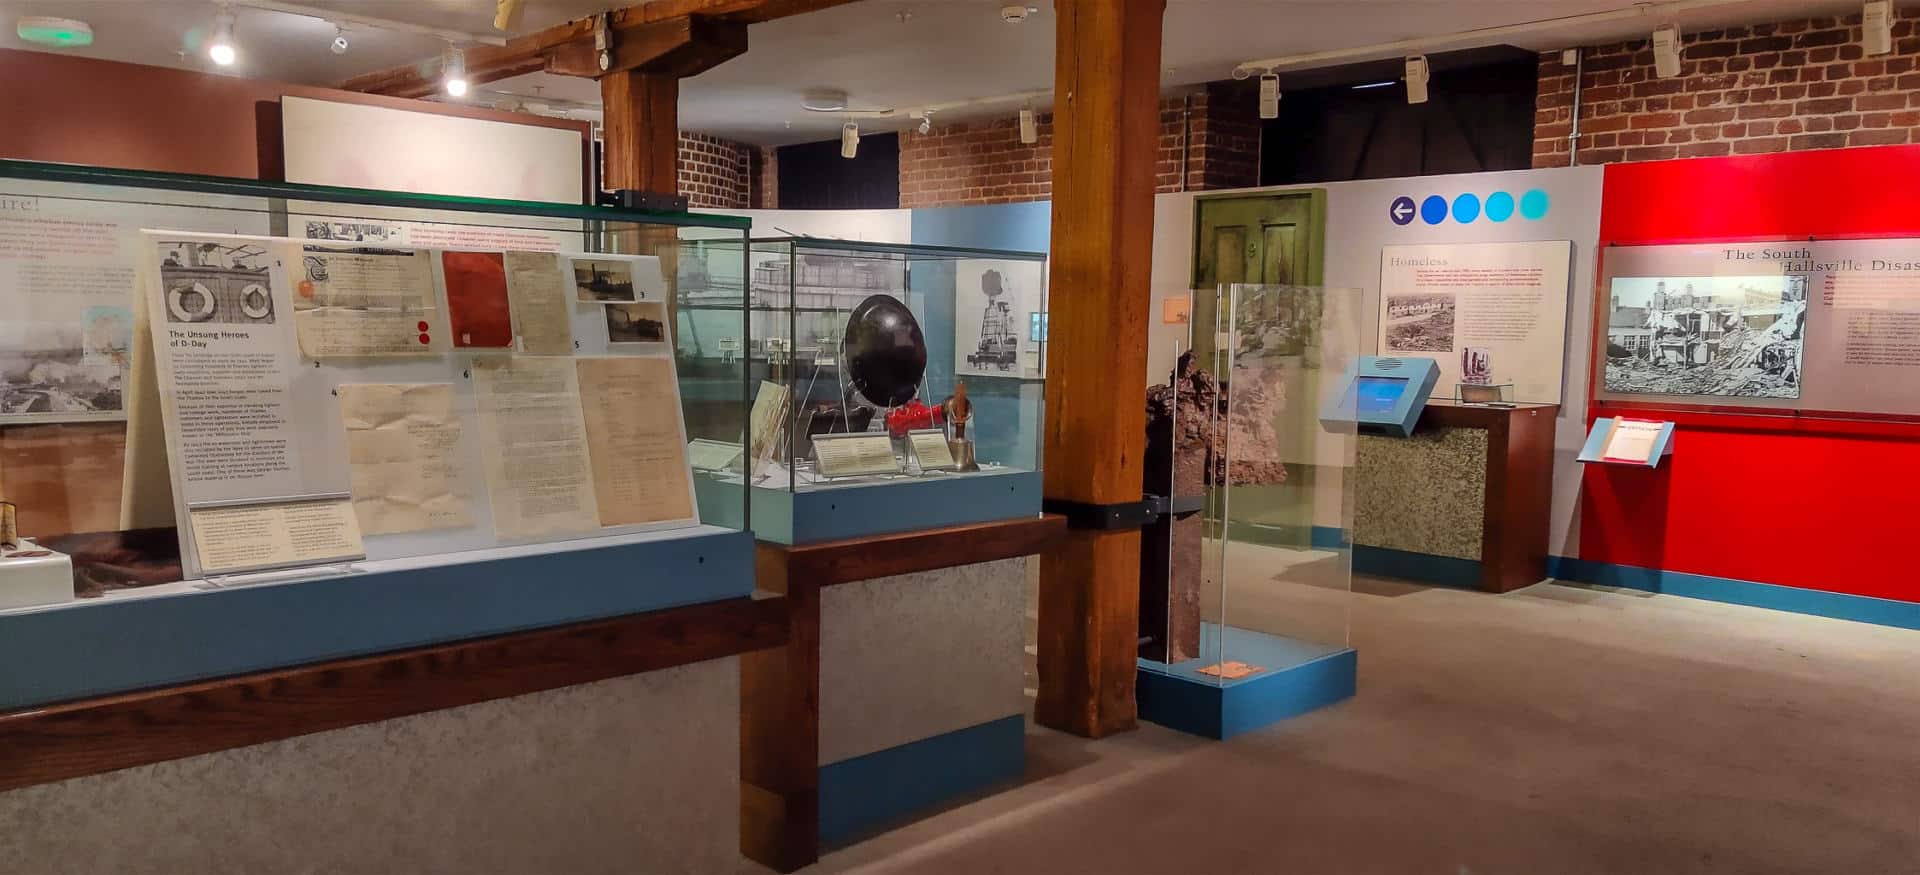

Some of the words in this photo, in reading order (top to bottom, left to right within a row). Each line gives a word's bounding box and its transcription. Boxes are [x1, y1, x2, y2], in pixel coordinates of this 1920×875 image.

[1724, 249, 1755, 260] The
[1762, 247, 1811, 259] South
[1391, 256, 1448, 266] Homeless
[1779, 259, 1864, 272] Hallsville
[169, 330, 185, 338] The
[187, 330, 218, 340] Unsung
[221, 330, 249, 339] Heroes
[181, 340, 207, 348] D-Day
